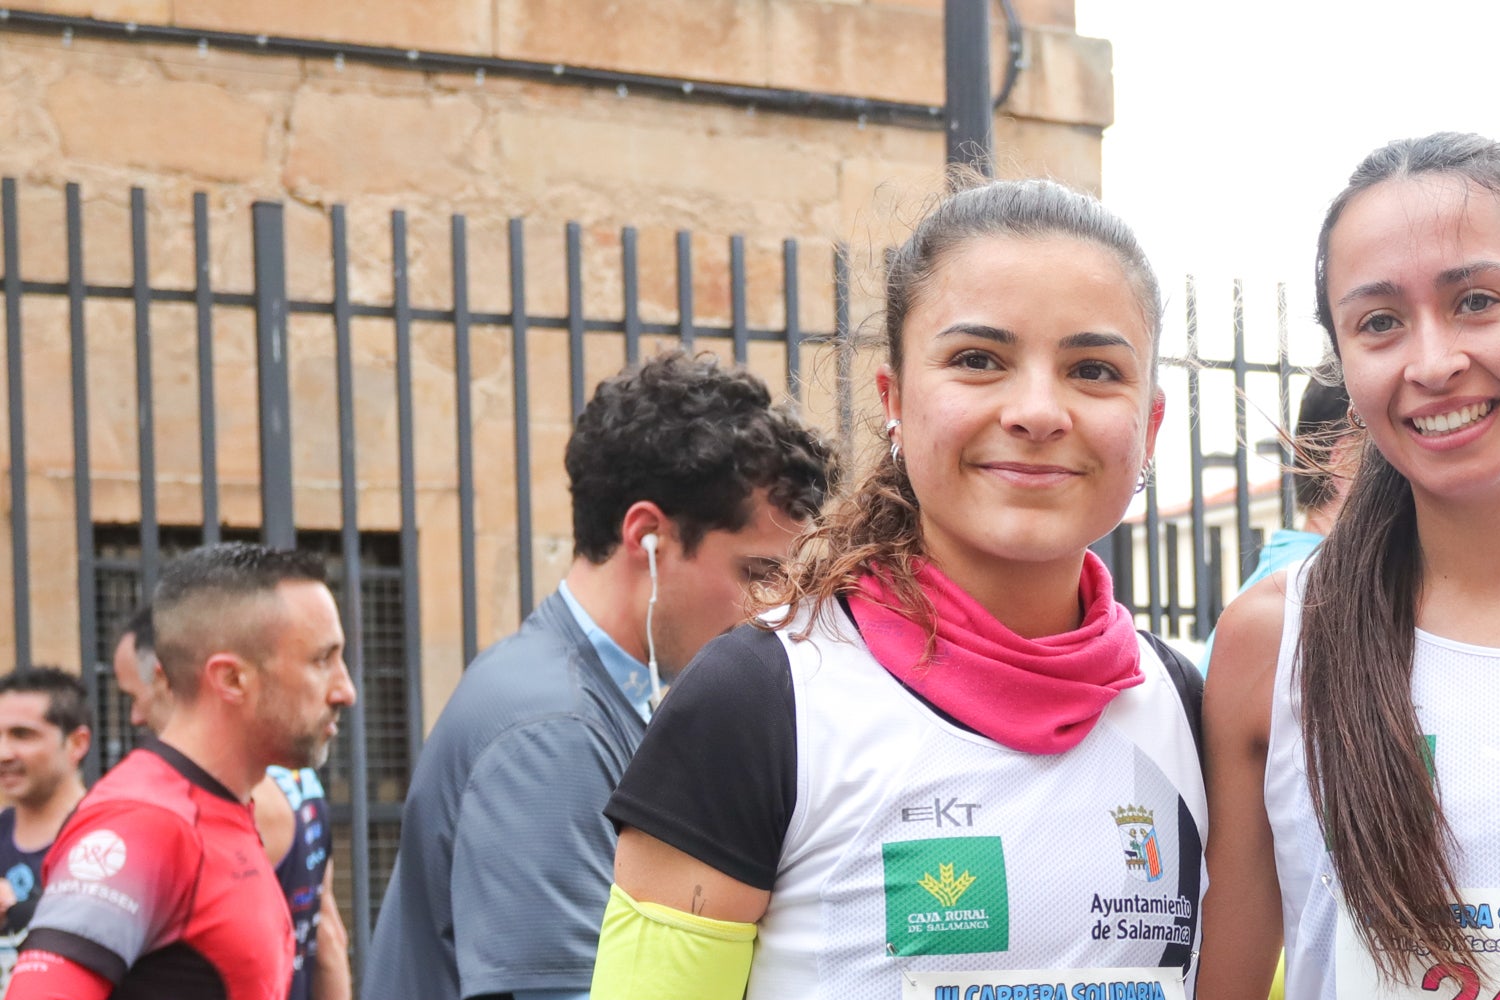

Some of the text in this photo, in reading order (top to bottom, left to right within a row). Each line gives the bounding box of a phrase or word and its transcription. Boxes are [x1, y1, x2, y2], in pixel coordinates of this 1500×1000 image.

[902, 797, 981, 828] EKT
[907, 909, 989, 924] CAJA RURAL
[1090, 893, 1191, 919] Ayuntamiento
[908, 920, 989, 934] DE SALAMANCA
[1091, 919, 1190, 944] de Salamanca
